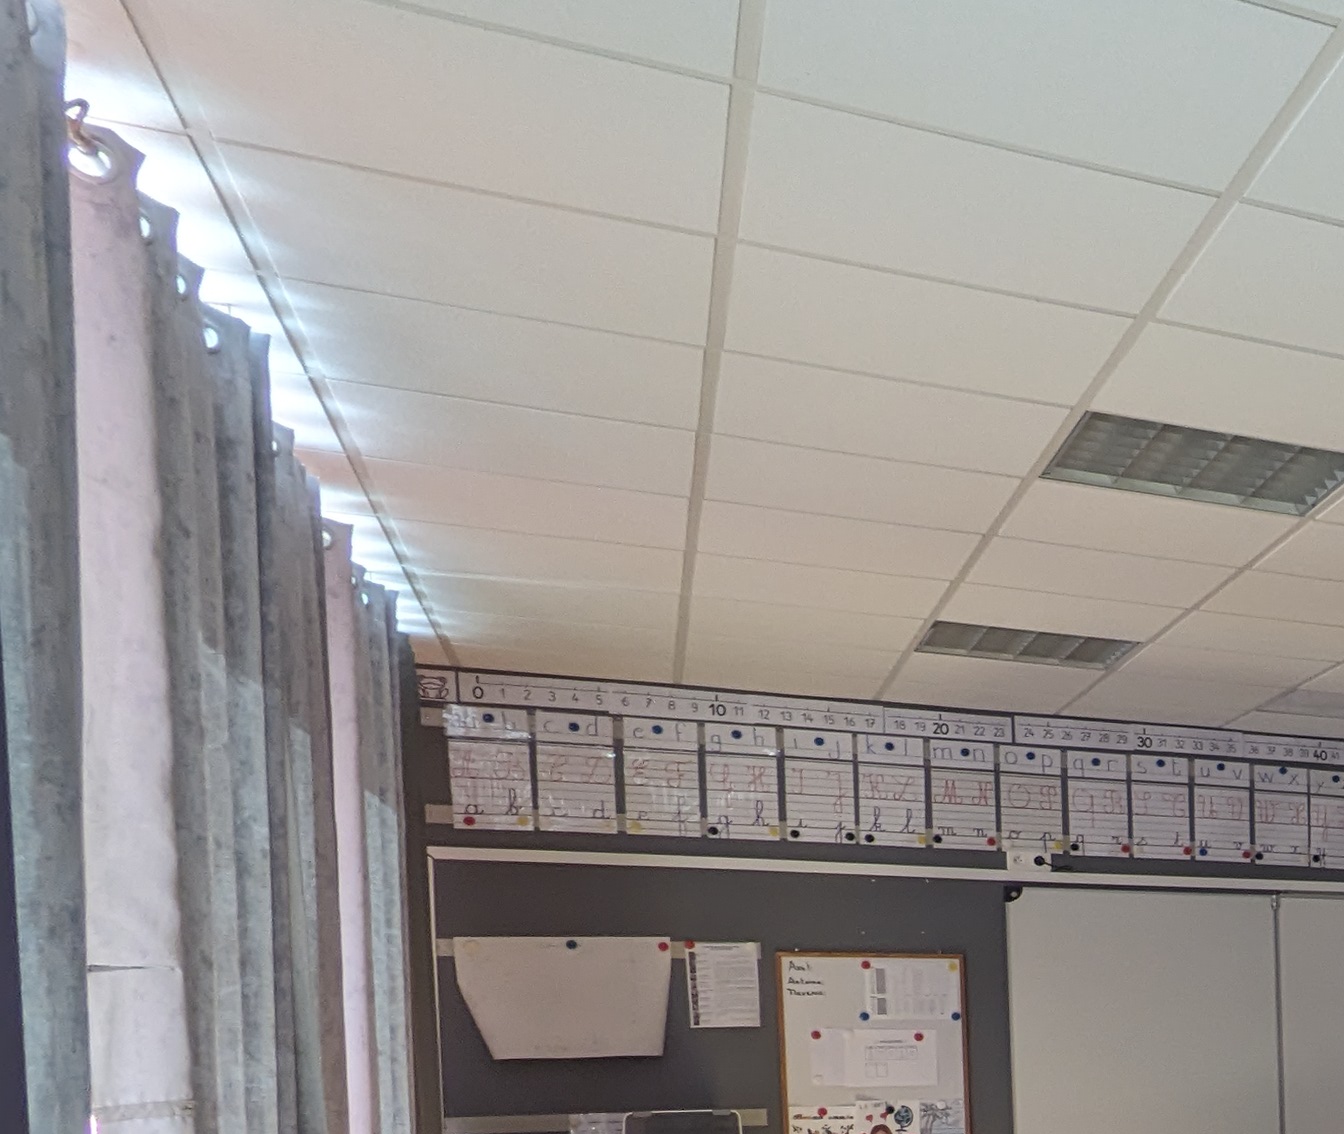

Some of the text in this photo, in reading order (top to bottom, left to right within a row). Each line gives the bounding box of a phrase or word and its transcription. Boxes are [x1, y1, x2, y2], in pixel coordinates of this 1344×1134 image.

[472, 686, 484, 699] 0
[499, 688, 505, 698] 1
[523, 689, 531, 701] 2
[548, 691, 556, 702] 3
[572, 693, 579, 702] 4
[595, 694, 603, 705] 5
[621, 696, 630, 707] 6
[646, 698, 653, 708] 7
[668, 700, 676, 710] 8
[691, 702, 698, 713] 9
[709, 703, 727, 716] 10
[733, 706, 744, 716] 11
[758, 709, 770, 720] 12
[780, 711, 792, 721] 13
[801, 713, 814, 723] 14
[823, 714, 835, 725] 15
[843, 716, 856, 727] 16
[865, 718, 875, 728] 17
[894, 720, 906, 730] 18
[914, 722, 926, 732] 19
[933, 722, 949, 735] 20
[954, 724, 965, 734] 21
[973, 726, 986, 736] 22
[993, 727, 1005, 738] 23
[1024, 728, 1035, 738] 24
[1042, 729, 1054, 739] 25
[1061, 730, 1073, 740] 26
[1080, 732, 1091, 741] 27
[1099, 733, 1110, 743] 28
[1116, 734, 1128, 744] 29
[1137, 736, 1153, 748] 30
[1157, 738, 1167, 747] 31
[1175, 739, 1185, 749] 32
[1192, 740, 1203, 751] 33
[1209, 742, 1220, 752] 34
[1226, 743, 1237, 753] 35
[1313, 750, 1328, 761] 40
[543, 715, 598, 736] c d
[633, 722, 686, 742] e f
[710, 727, 764, 751] g h
[793, 736, 840, 759] i j
[865, 735, 908, 756] k l
[932, 746, 985, 762] m n
[1004, 751, 1053, 772] o p
[1073, 757, 1117, 777] q r
[1136, 760, 1181, 775] s t
[1201, 766, 1243, 780] u v
[1259, 772, 1299, 786] w x
[1317, 781, 1324, 793] y
